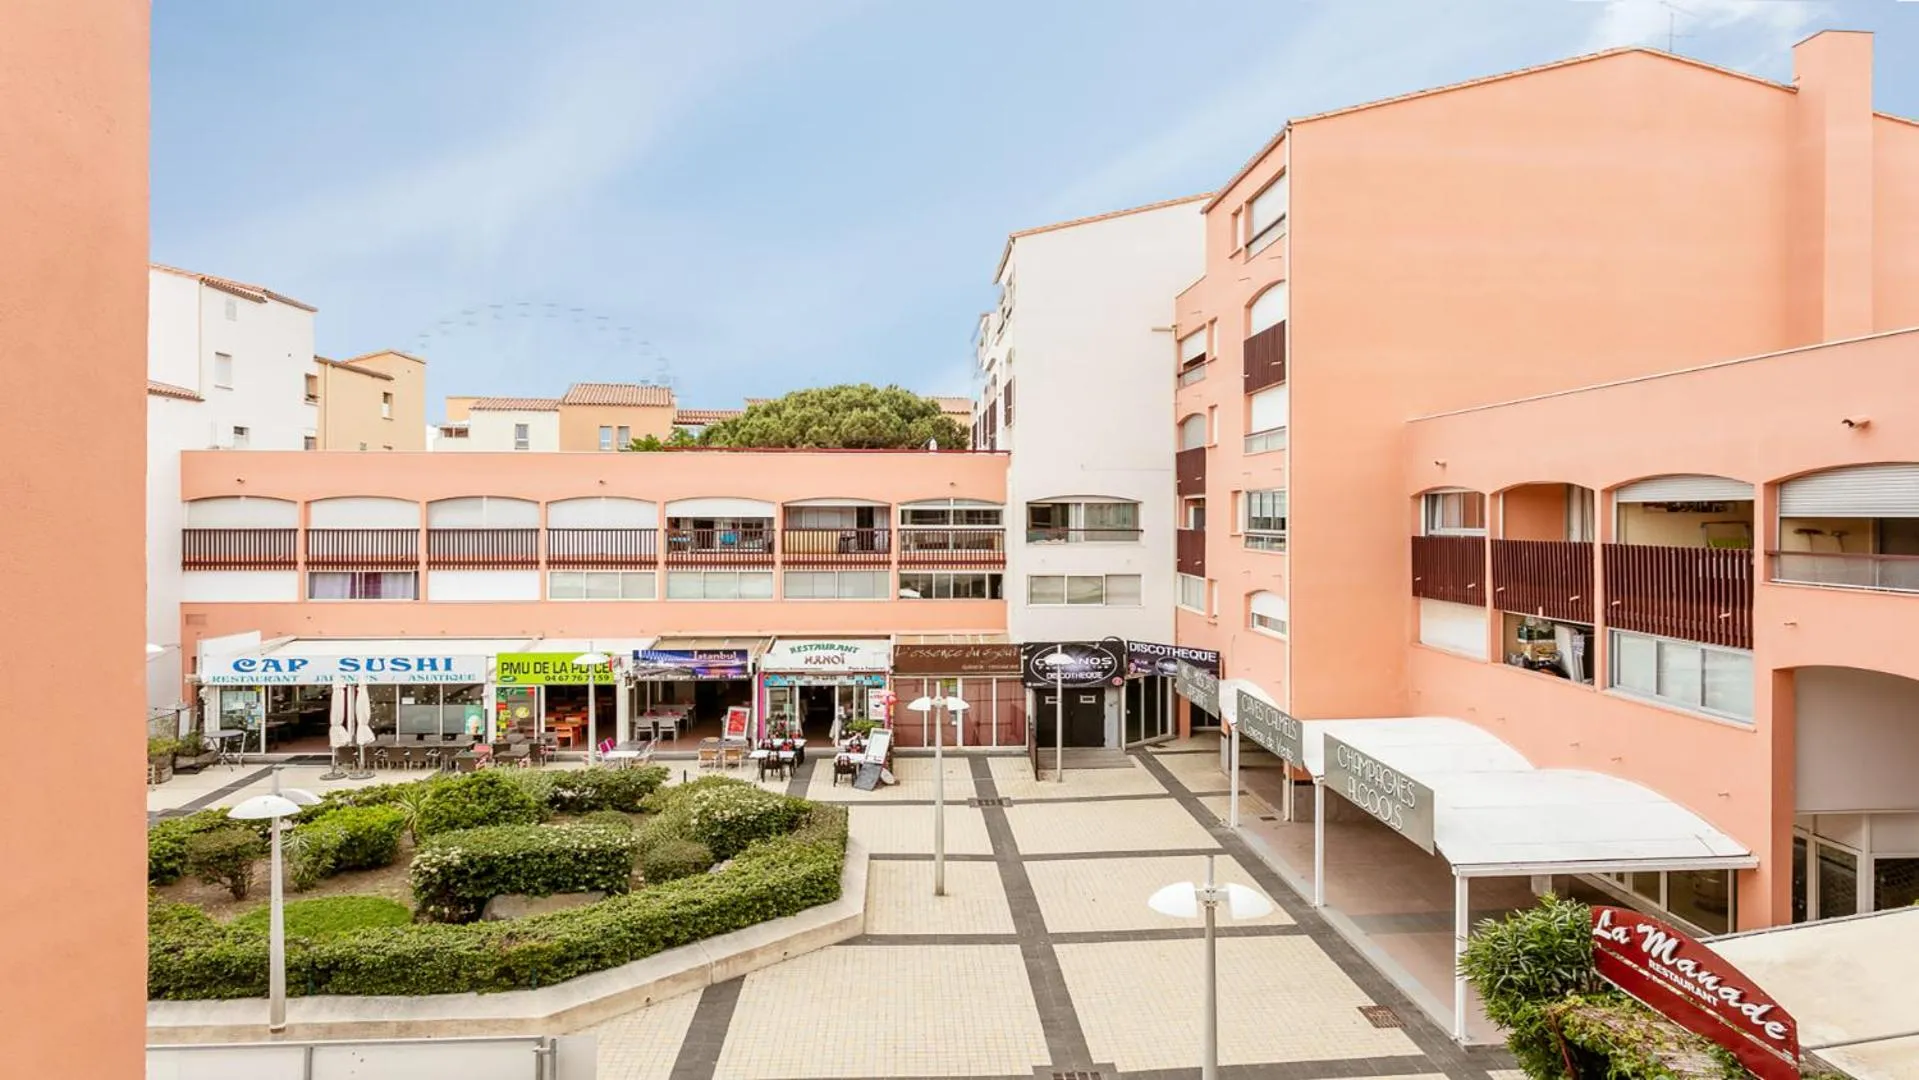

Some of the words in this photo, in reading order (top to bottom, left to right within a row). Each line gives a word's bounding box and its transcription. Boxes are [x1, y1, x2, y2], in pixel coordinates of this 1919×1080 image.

[694, 650, 738, 660] Istanbul
[789, 643, 860, 655] RESTAURANT
[1129, 642, 1217, 662] DISCOTHEQUE
[232, 658, 309, 672] CAP
[339, 657, 452, 672] SUSHI
[501, 662, 530, 675] PMU
[534, 662, 549, 674] DE
[553, 662, 567, 674] LA
[212, 675, 300, 683] RESTAURANT
[409, 674, 476, 682] ASIATIQUE
[1337, 744, 1416, 809] CHAMPAGNES
[1347, 776, 1404, 831] ALCOOLS
[1592, 909, 1630, 944] La
[1636, 923, 1788, 1040] Manade
[1648, 959, 1720, 1006] RESTAURANT
